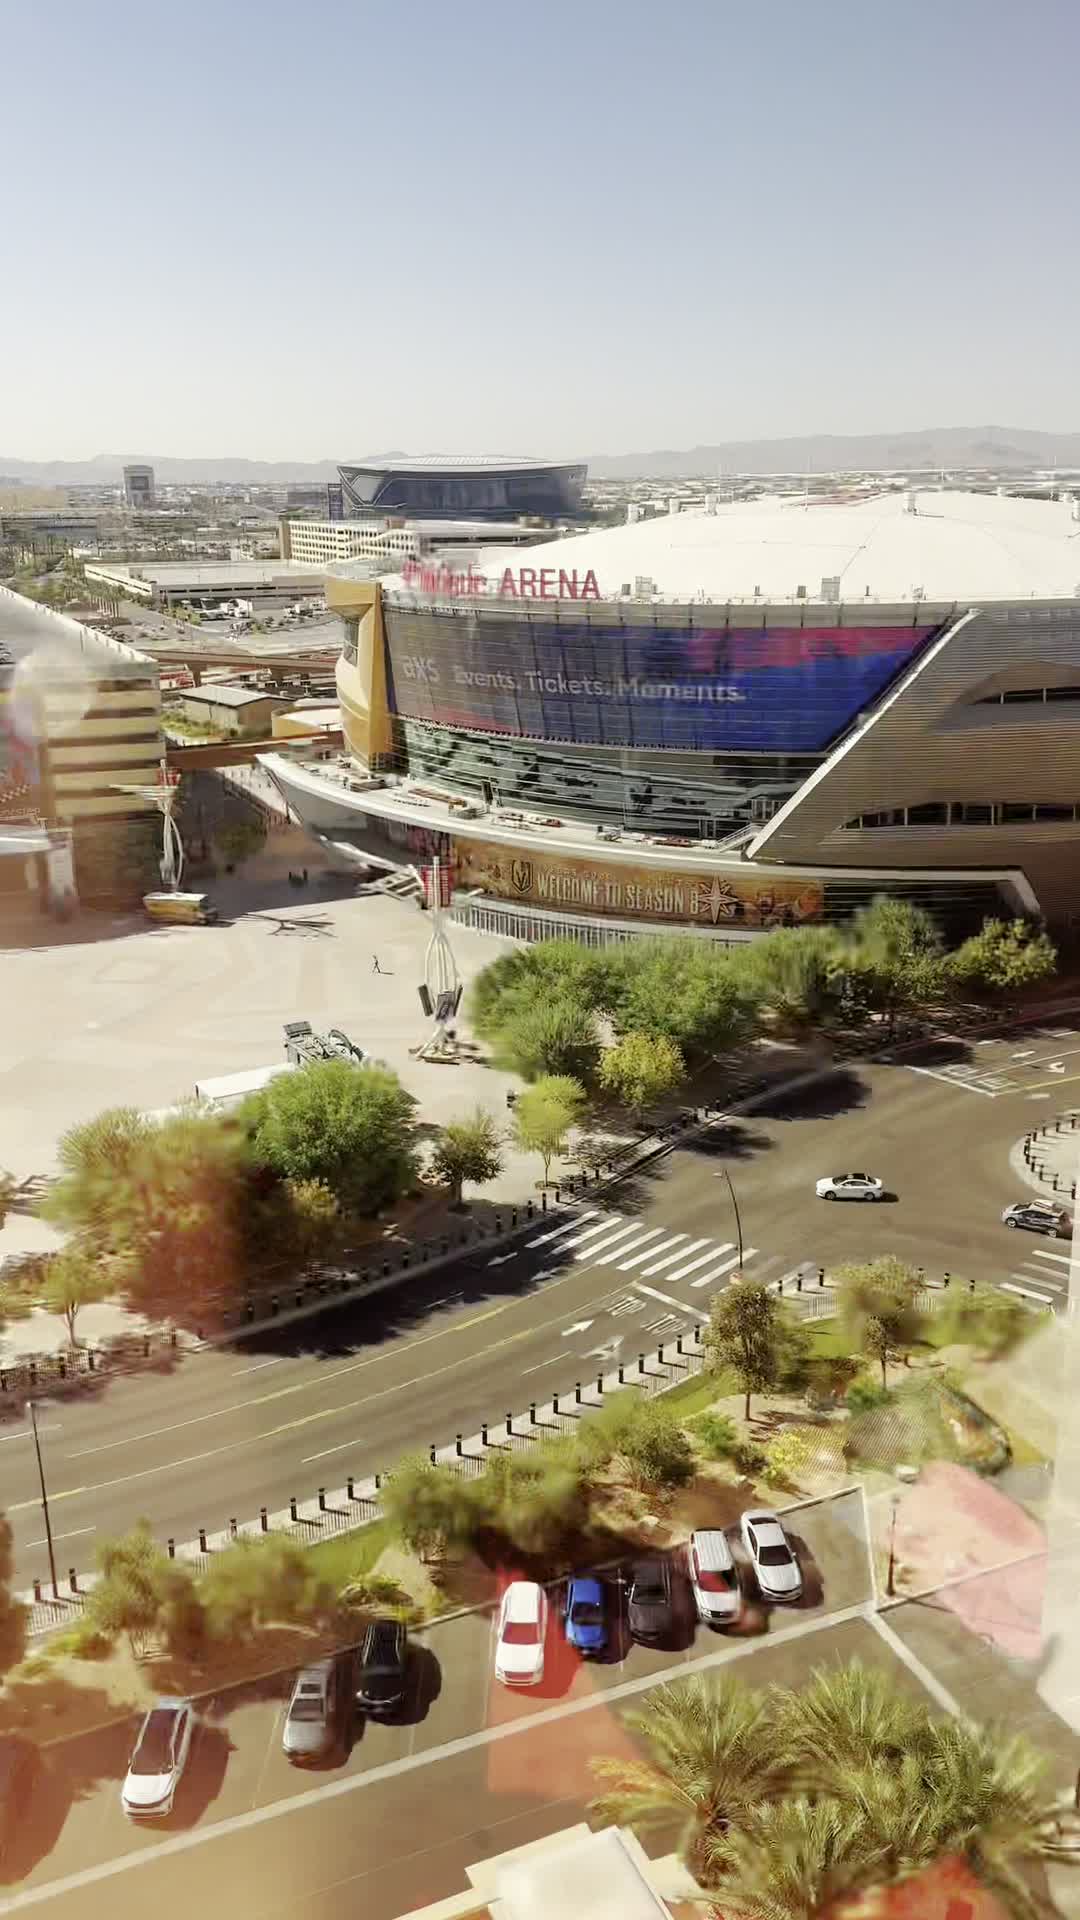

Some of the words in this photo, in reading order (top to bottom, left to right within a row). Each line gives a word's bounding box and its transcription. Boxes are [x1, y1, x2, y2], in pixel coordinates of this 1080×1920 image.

[499, 567, 602, 600] ARENA
[537, 872, 599, 905] WELCOME
[626, 883, 684, 913] SEASON
